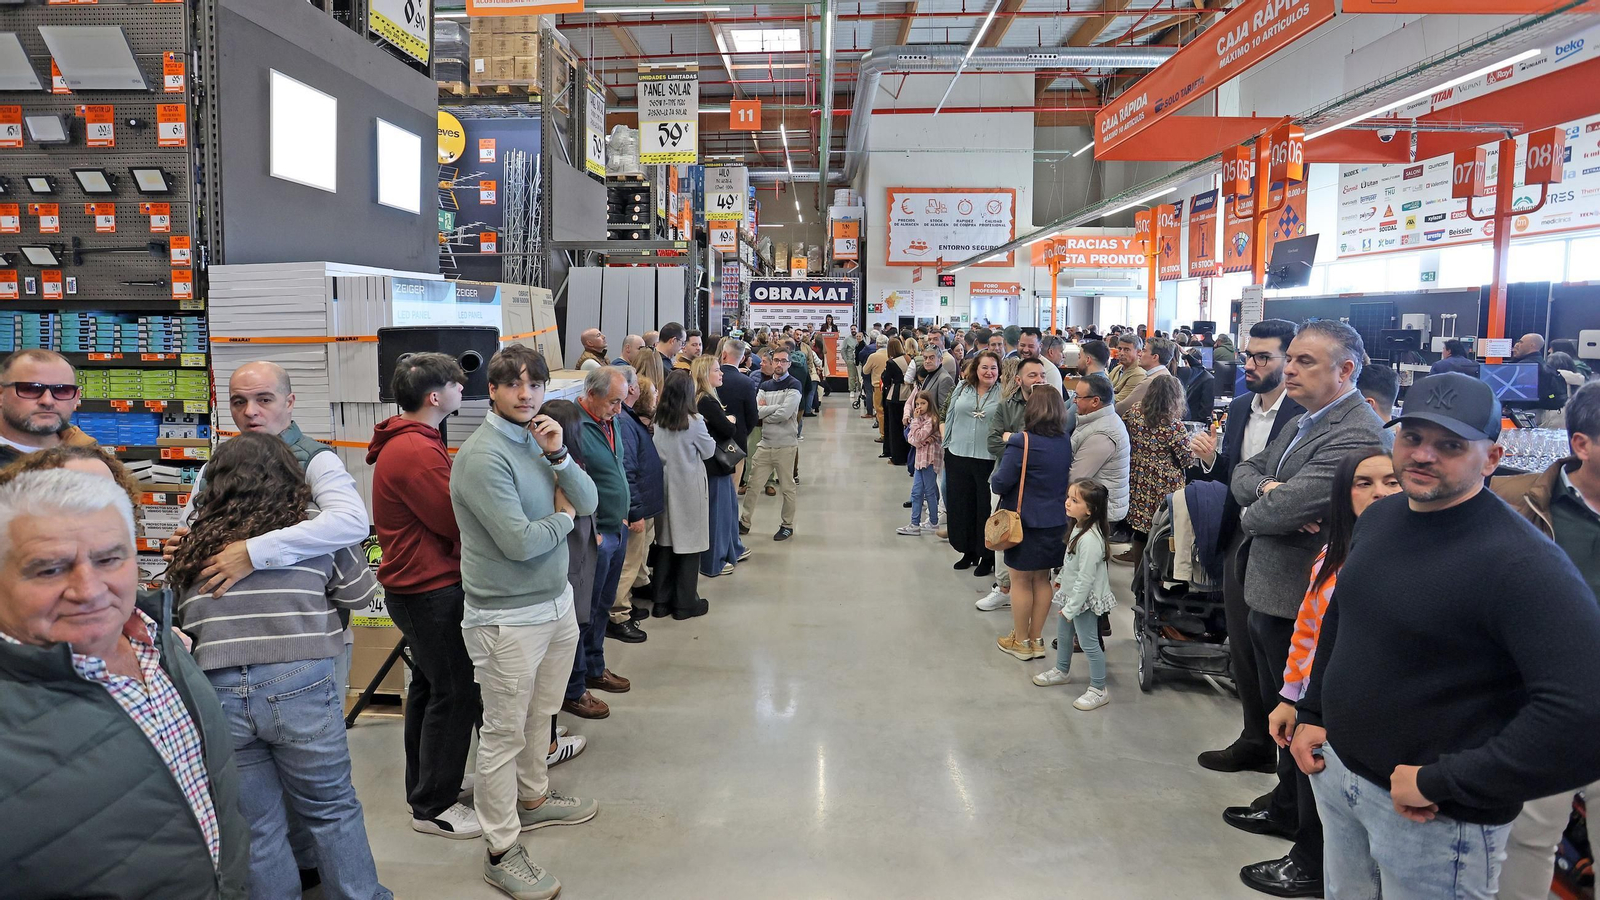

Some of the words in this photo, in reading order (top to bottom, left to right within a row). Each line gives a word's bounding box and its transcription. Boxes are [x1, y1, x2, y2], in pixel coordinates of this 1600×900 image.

[1216, 20, 1248, 56] CAJA
[1219, 42, 1250, 68] MÁXIMO
[1252, 36, 1260, 48] 10
[1262, 3, 1309, 42] ARTÍCULOS
[1555, 38, 1584, 56] beko
[644, 83, 665, 96] PANEL
[669, 83, 691, 96] SOLAR
[1164, 92, 1179, 108] SOLO
[1180, 76, 1204, 97] TARJETA
[1431, 88, 1454, 104] TITAN
[738, 109, 753, 122] 11
[1102, 114, 1118, 134] CAJA
[1119, 92, 1147, 122] RÁPIDA
[1103, 129, 1118, 143] MÁXIMO
[1124, 112, 1144, 131] ARTÍCULOS
[1272, 141, 1287, 167] 06
[1289, 140, 1302, 165] 06
[1528, 144, 1551, 169] 08
[1553, 143, 1564, 167] 08
[1223, 160, 1236, 182] 05
[1236, 159, 1249, 180] 05
[1405, 168, 1421, 177] SALONI
[1454, 161, 1474, 184] 07
[1475, 160, 1484, 182] 07
[1162, 213, 1173, 228] 04
[1541, 216, 1571, 225] mediclinics
[1449, 227, 1472, 235] Beissier
[1066, 240, 1117, 249] RACIAS
[1122, 240, 1131, 249] Y
[1090, 254, 1145, 264] PRONTO
[1199, 260, 1214, 268] STOCK
[396, 283, 425, 294] ZEIGER
[457, 289, 478, 297] ZEIGER
[754, 287, 848, 300] OBRAMAT
[398, 311, 410, 319] LED
[412, 311, 431, 319] PANEL
[1427, 386, 1457, 410] NY
[369, 598, 383, 612] 24
